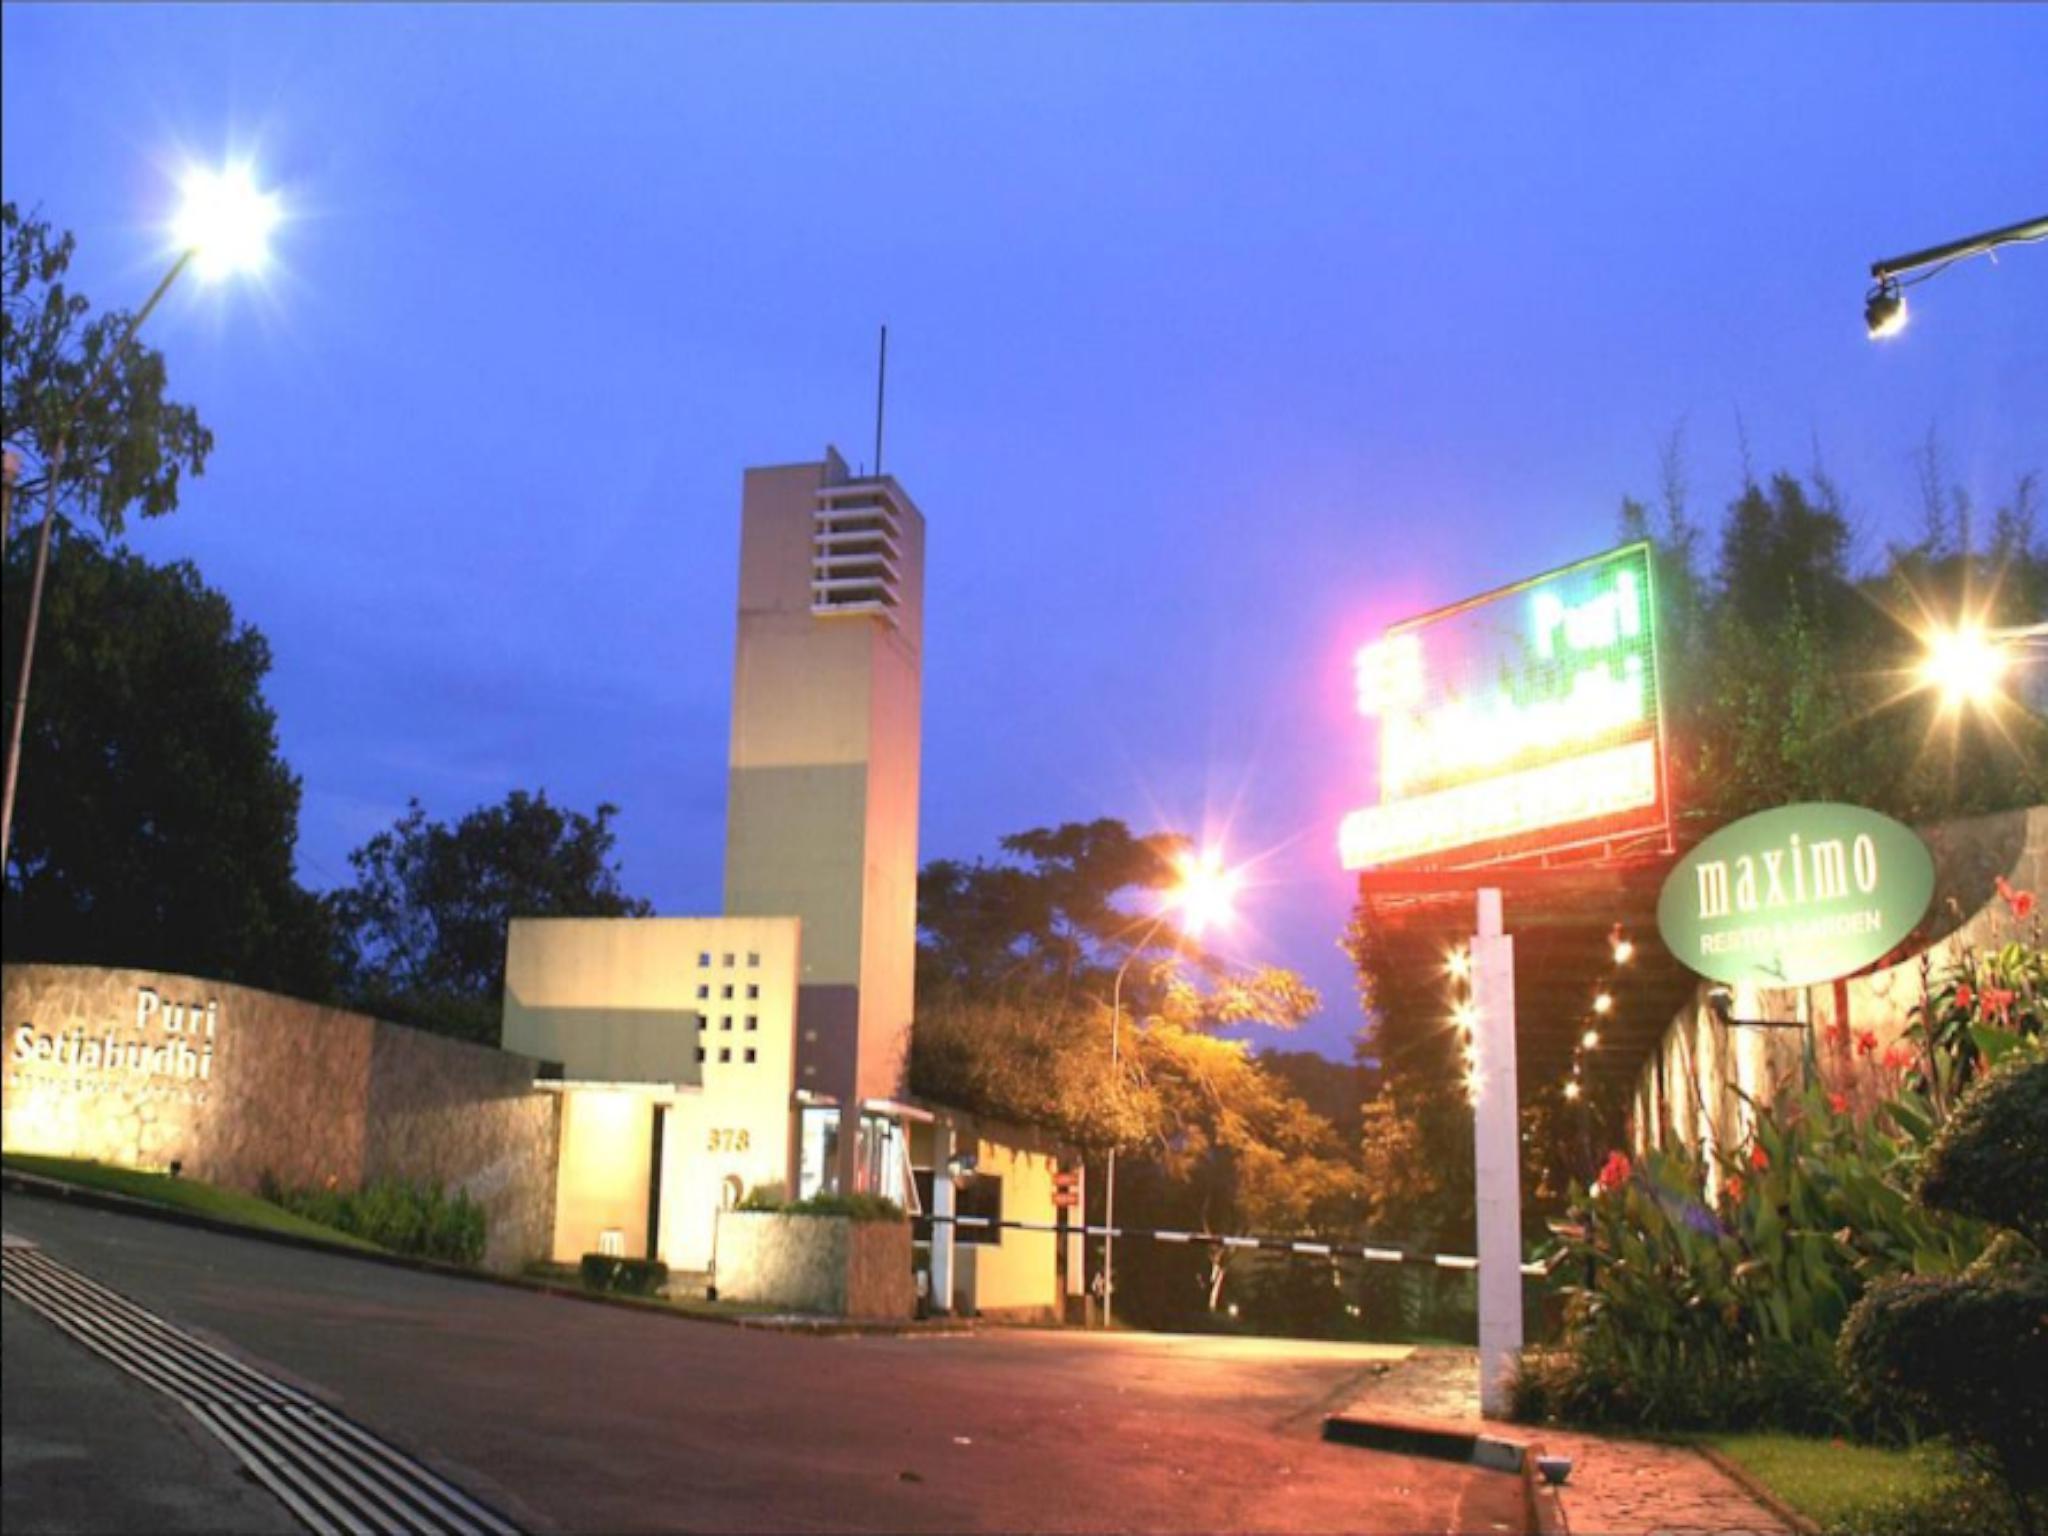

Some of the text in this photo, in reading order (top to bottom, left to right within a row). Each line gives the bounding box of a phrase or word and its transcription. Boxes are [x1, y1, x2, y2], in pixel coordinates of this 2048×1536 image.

[1696, 833, 1877, 919] maximo
[136, 986, 217, 1037] Puri
[11, 1023, 213, 1080] Setiabudhi
